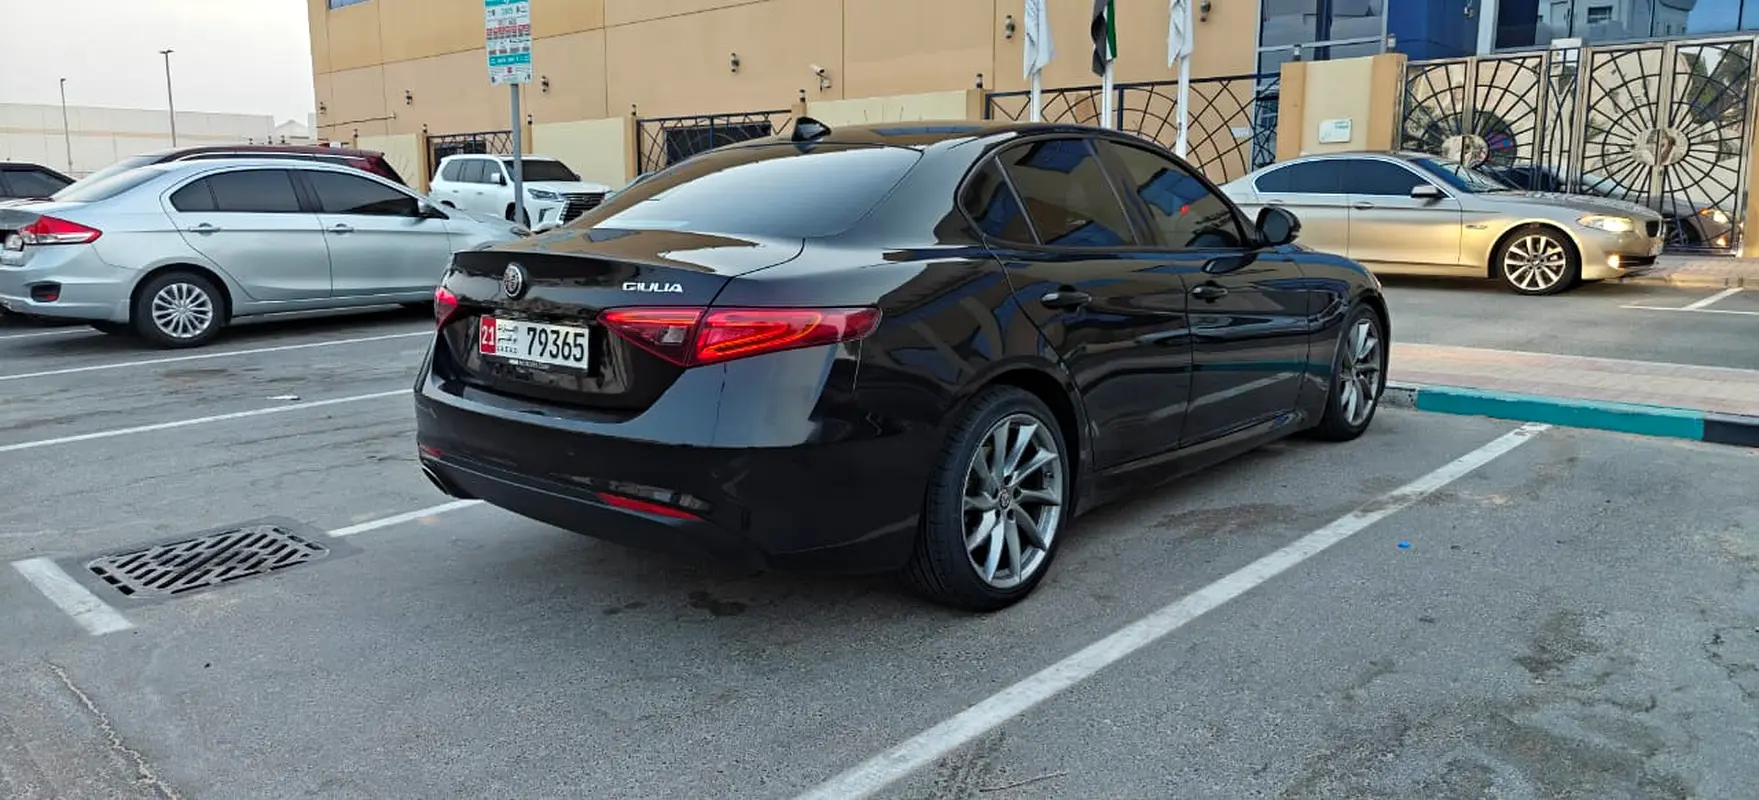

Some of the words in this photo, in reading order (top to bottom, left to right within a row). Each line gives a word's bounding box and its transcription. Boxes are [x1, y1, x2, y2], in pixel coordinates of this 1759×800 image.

[622, 282, 683, 293] GIULIA
[481, 326, 495, 345] 21
[527, 327, 585, 362] 79365
